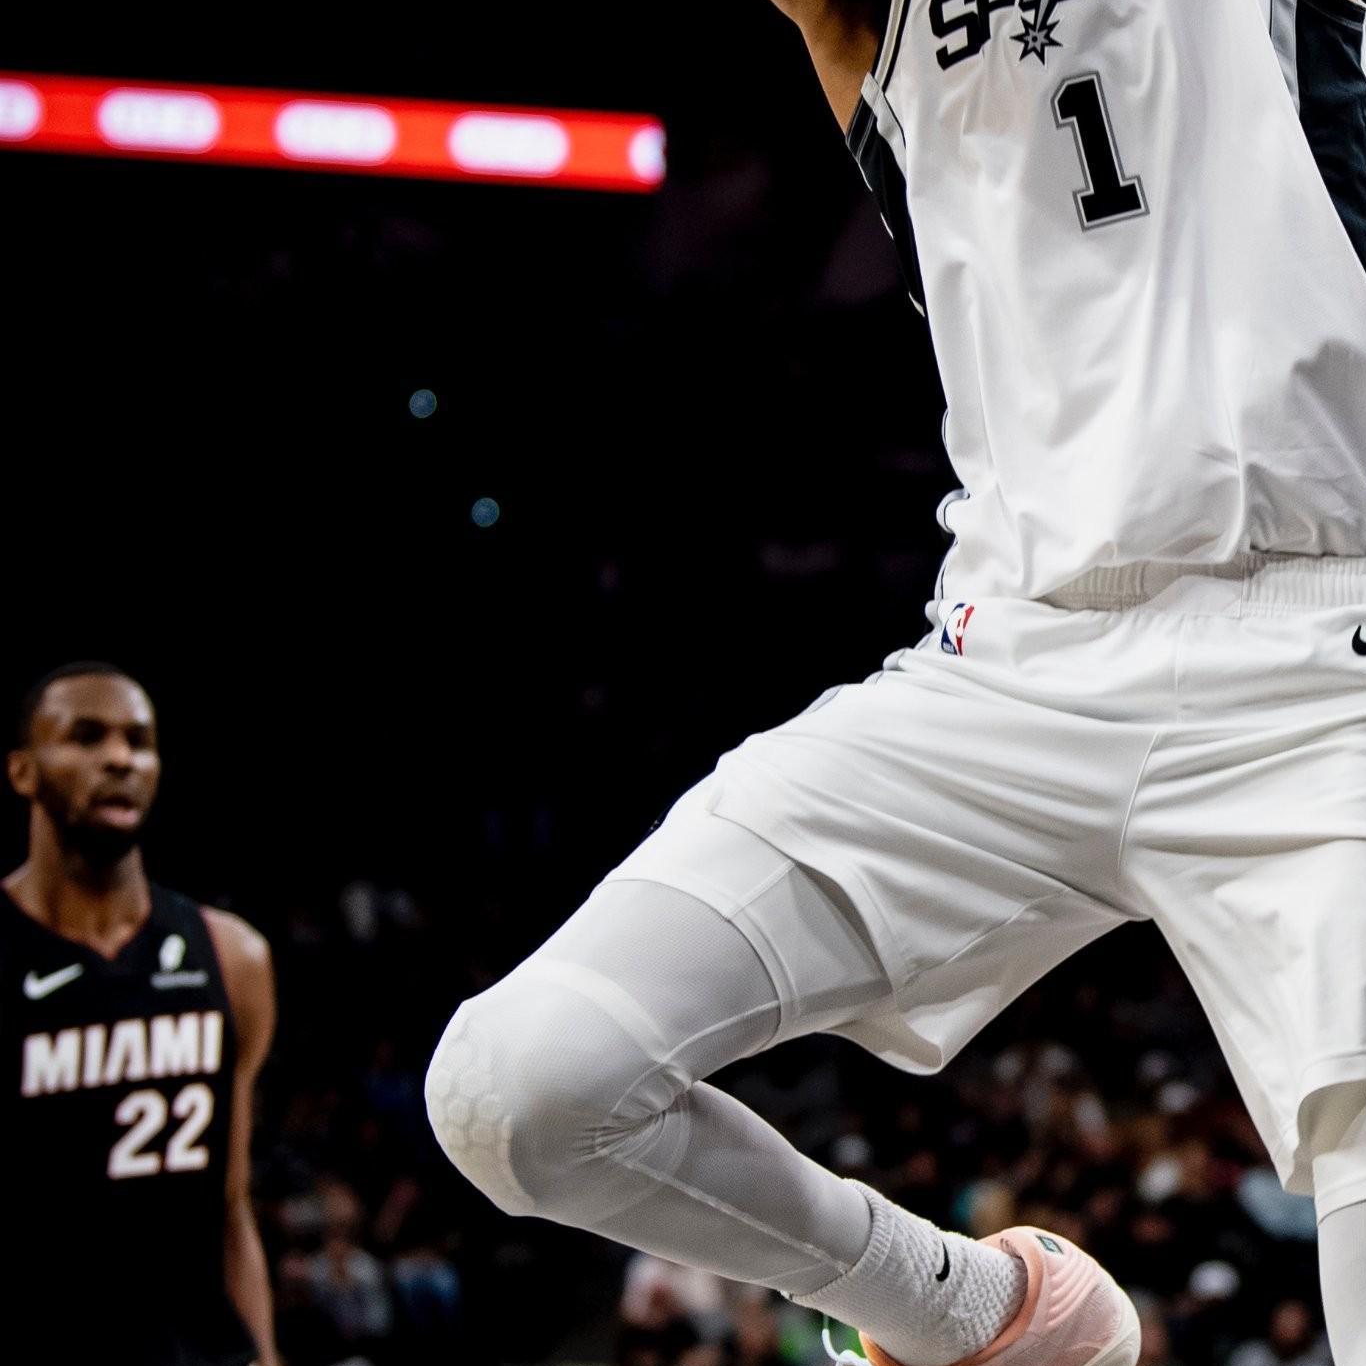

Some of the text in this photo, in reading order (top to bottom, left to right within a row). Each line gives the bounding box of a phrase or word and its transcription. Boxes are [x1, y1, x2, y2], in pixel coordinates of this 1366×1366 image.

[1050, 72, 1150, 232] 1
[22, 1012, 223, 1097] MIAMI
[107, 1082, 214, 1180] 22
